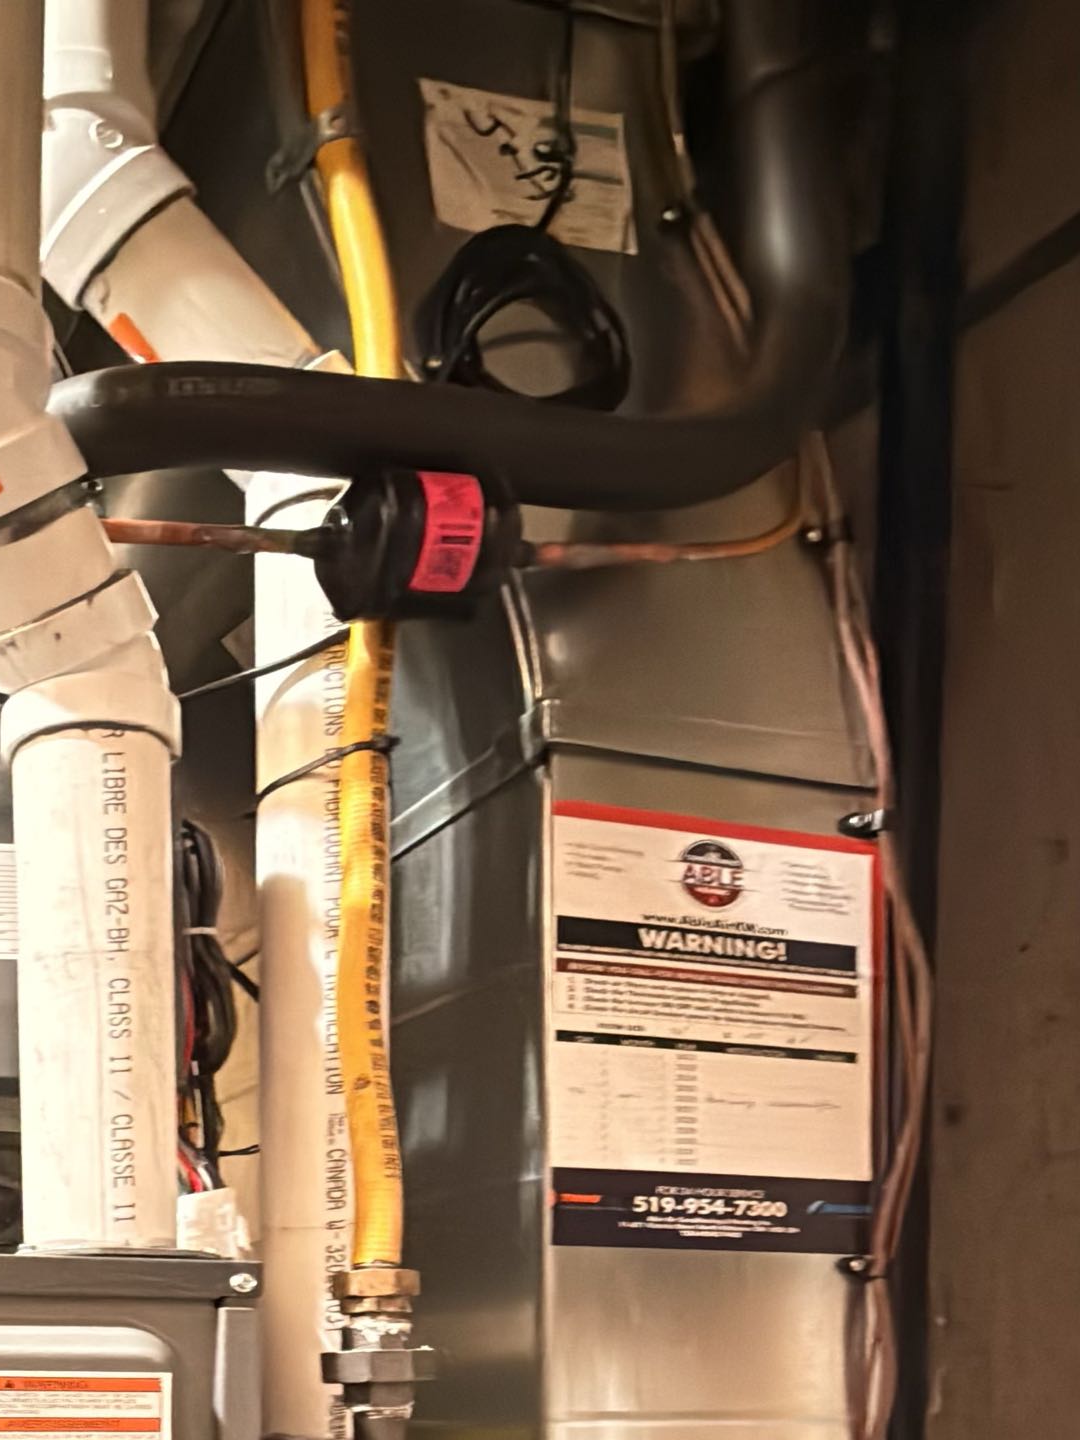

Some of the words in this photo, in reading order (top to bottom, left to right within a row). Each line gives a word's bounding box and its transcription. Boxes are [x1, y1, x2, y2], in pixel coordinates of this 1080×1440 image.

[102, 752, 127, 815] LIBRE
[103, 827, 128, 865] DES
[637, 927, 789, 962] WARNING!
[108, 978, 133, 1040] CLASS
[111, 1112, 136, 1188] CLASSE
[326, 1147, 348, 1211] CANADA
